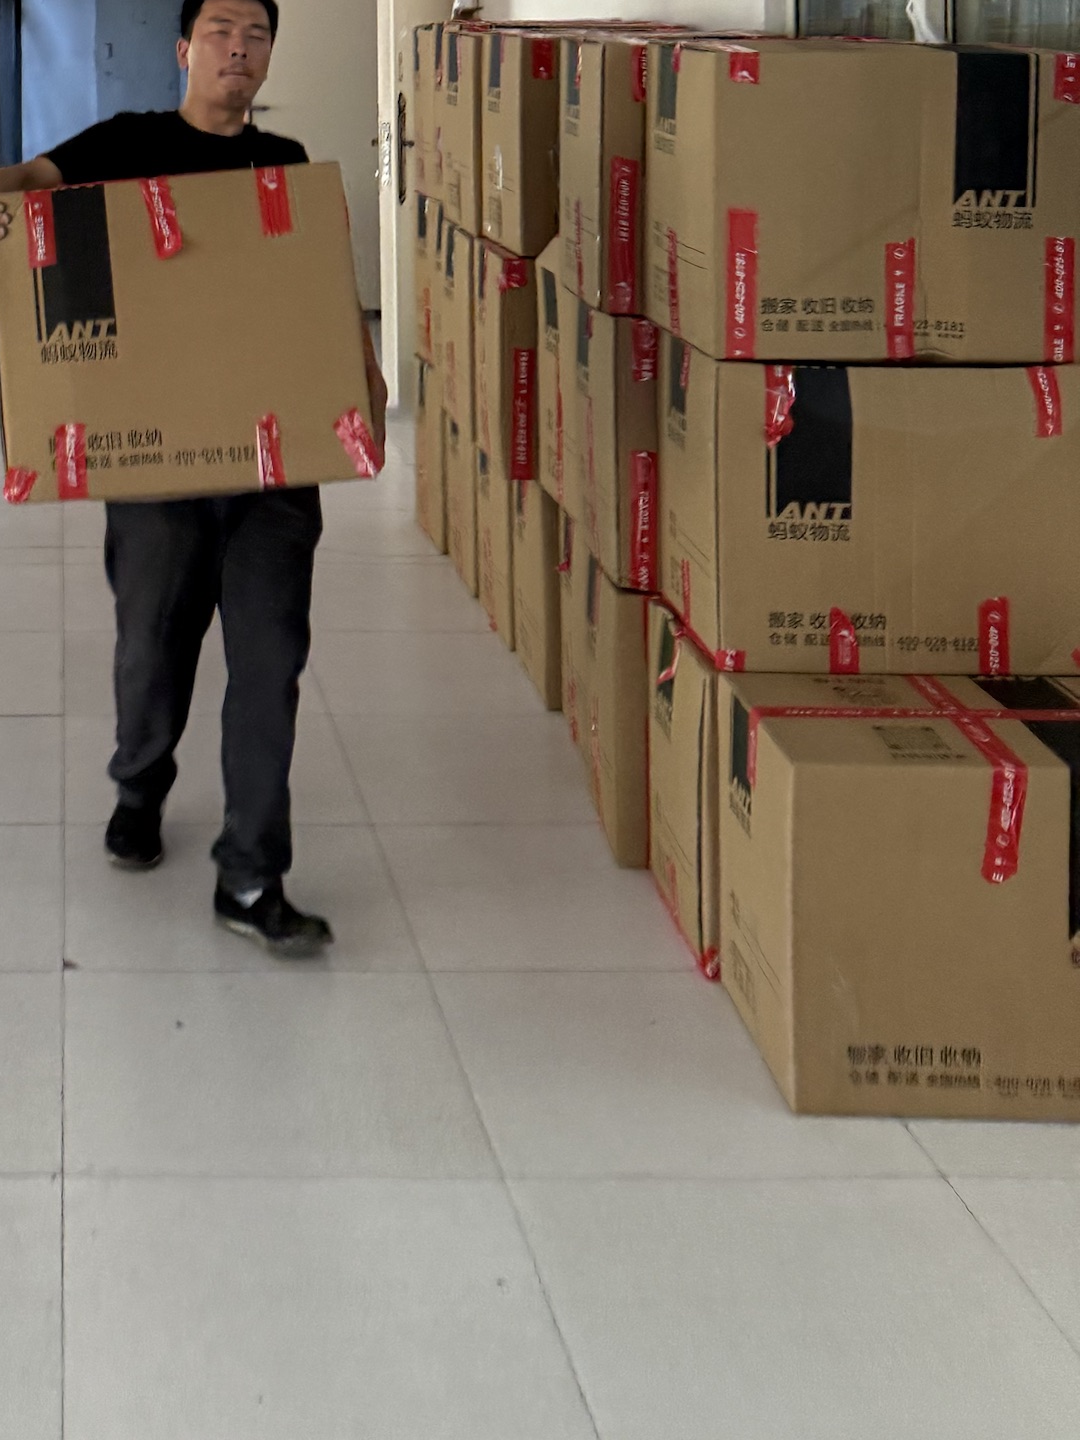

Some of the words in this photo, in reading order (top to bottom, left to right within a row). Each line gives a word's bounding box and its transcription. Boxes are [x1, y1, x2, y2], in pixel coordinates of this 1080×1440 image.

[955, 189, 1026, 208] ANT
[951, 210, 1033, 229] 蚂蚁物流
[895, 282, 905, 327] FRAGILE
[46, 318, 115, 343] ANT
[776, 501, 852, 520] ANT
[768, 521, 851, 542] 蚂蚁物流
